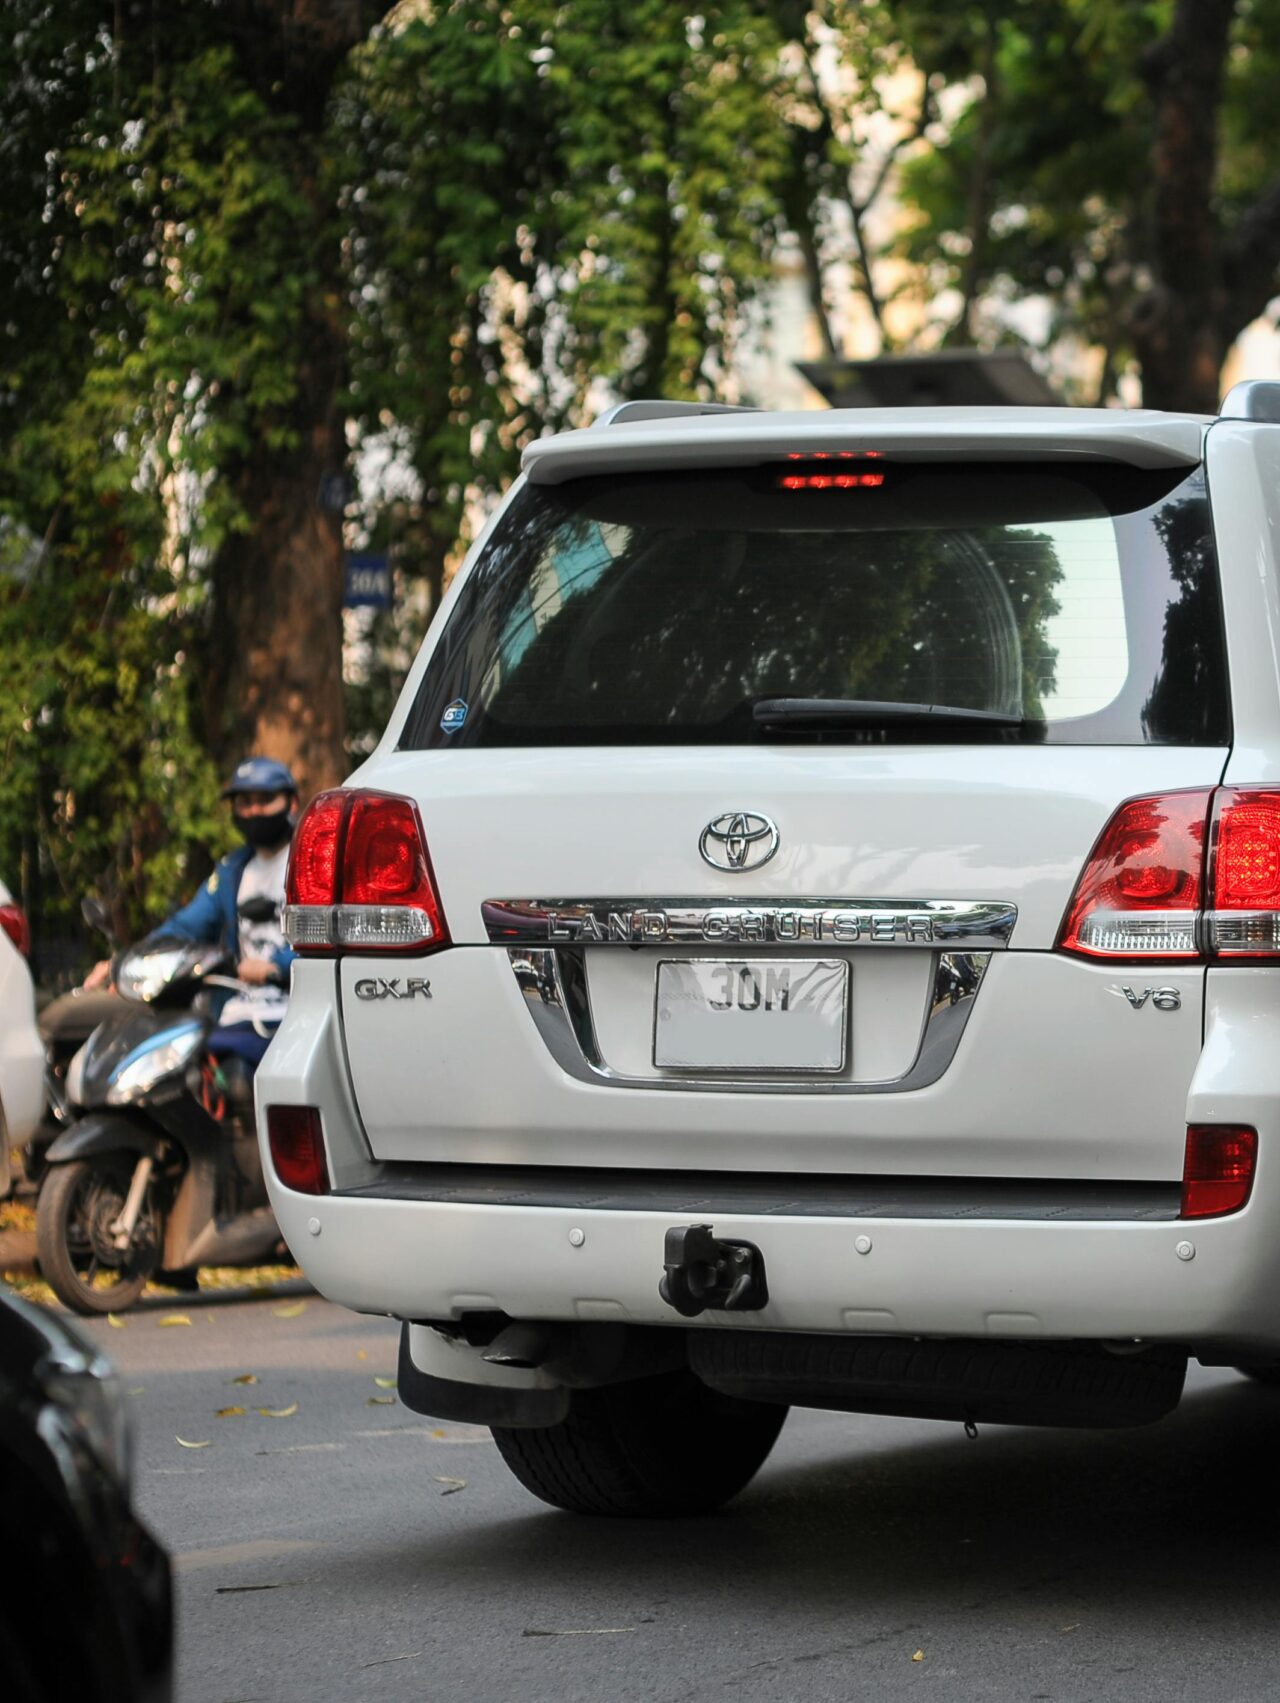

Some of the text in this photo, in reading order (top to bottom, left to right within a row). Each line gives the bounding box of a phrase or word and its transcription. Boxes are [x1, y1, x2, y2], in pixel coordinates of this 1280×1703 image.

[546, 912, 936, 943] LAND CRUISER
[710, 967, 791, 1012] 30M
[1121, 986, 1182, 1012] V6
